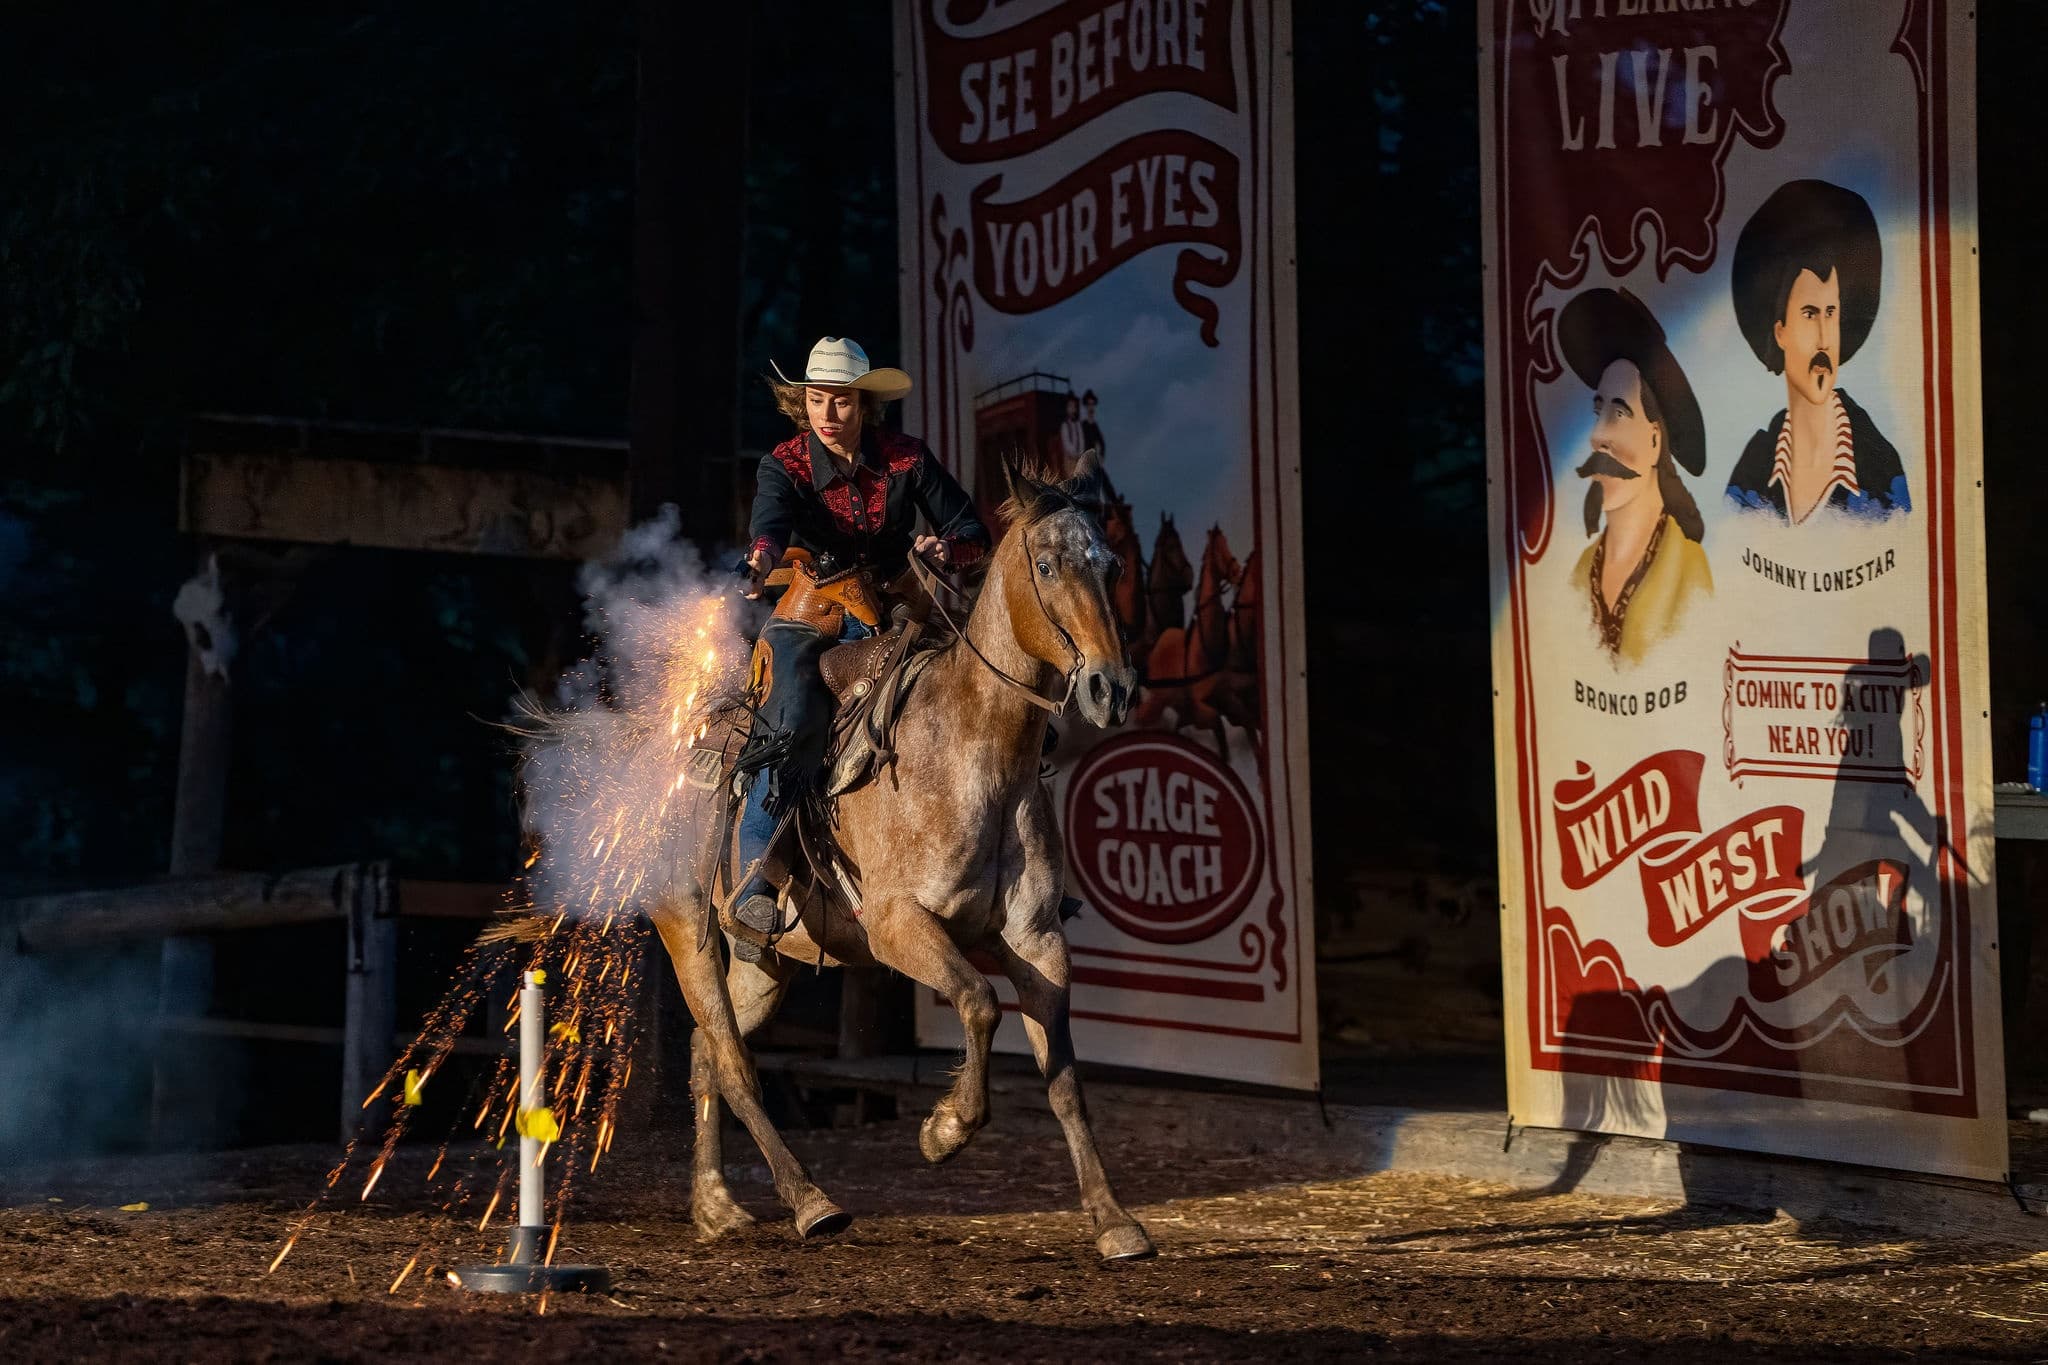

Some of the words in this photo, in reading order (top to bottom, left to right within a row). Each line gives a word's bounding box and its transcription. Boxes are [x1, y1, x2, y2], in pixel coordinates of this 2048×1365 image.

[960, 49, 1037, 144] SEE
[1051, 0, 1206, 118] BEFORE
[1551, 44, 1719, 151] LIVE
[986, 188, 1099, 297] YOUR
[1111, 154, 1220, 249] EYES
[1742, 547, 1807, 591] JOHNNY
[1814, 548, 1896, 593] LONESTAR
[1574, 679, 1638, 716] BRONCO
[1645, 680, 1689, 714] BOB
[1736, 678, 1806, 711] COMING
[1811, 681, 1838, 711] TO
[1843, 683, 1857, 712] A
[1860, 684, 1907, 714] CITY
[1768, 725, 1821, 755] NEAR
[1827, 726, 1876, 758] YOU!
[1094, 767, 1223, 837] STAGE
[1567, 768, 1671, 878] WILD
[1097, 838, 1223, 905] COACH
[1658, 817, 1785, 933] WEST
[1770, 873, 1892, 987] SHOW
